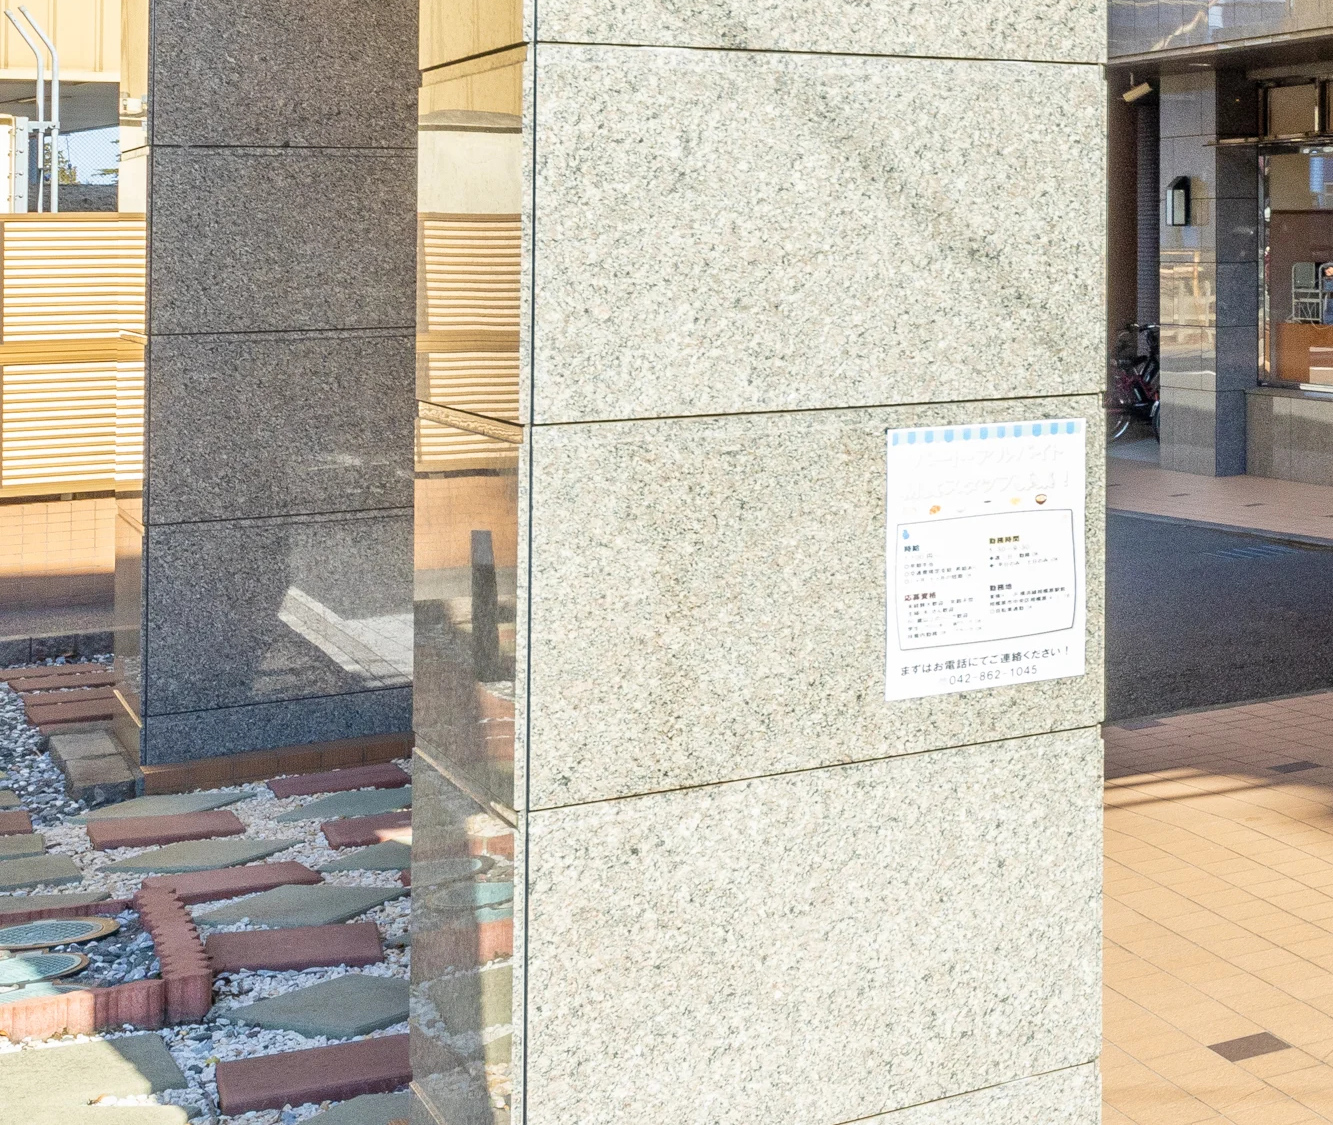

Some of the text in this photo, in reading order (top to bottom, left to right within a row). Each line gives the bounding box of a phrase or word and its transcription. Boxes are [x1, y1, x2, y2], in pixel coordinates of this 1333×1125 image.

[901, 645, 1069, 677] まずはお電話にてご連絡ください！
[949, 664, 1038, 686] 042-862-1045
